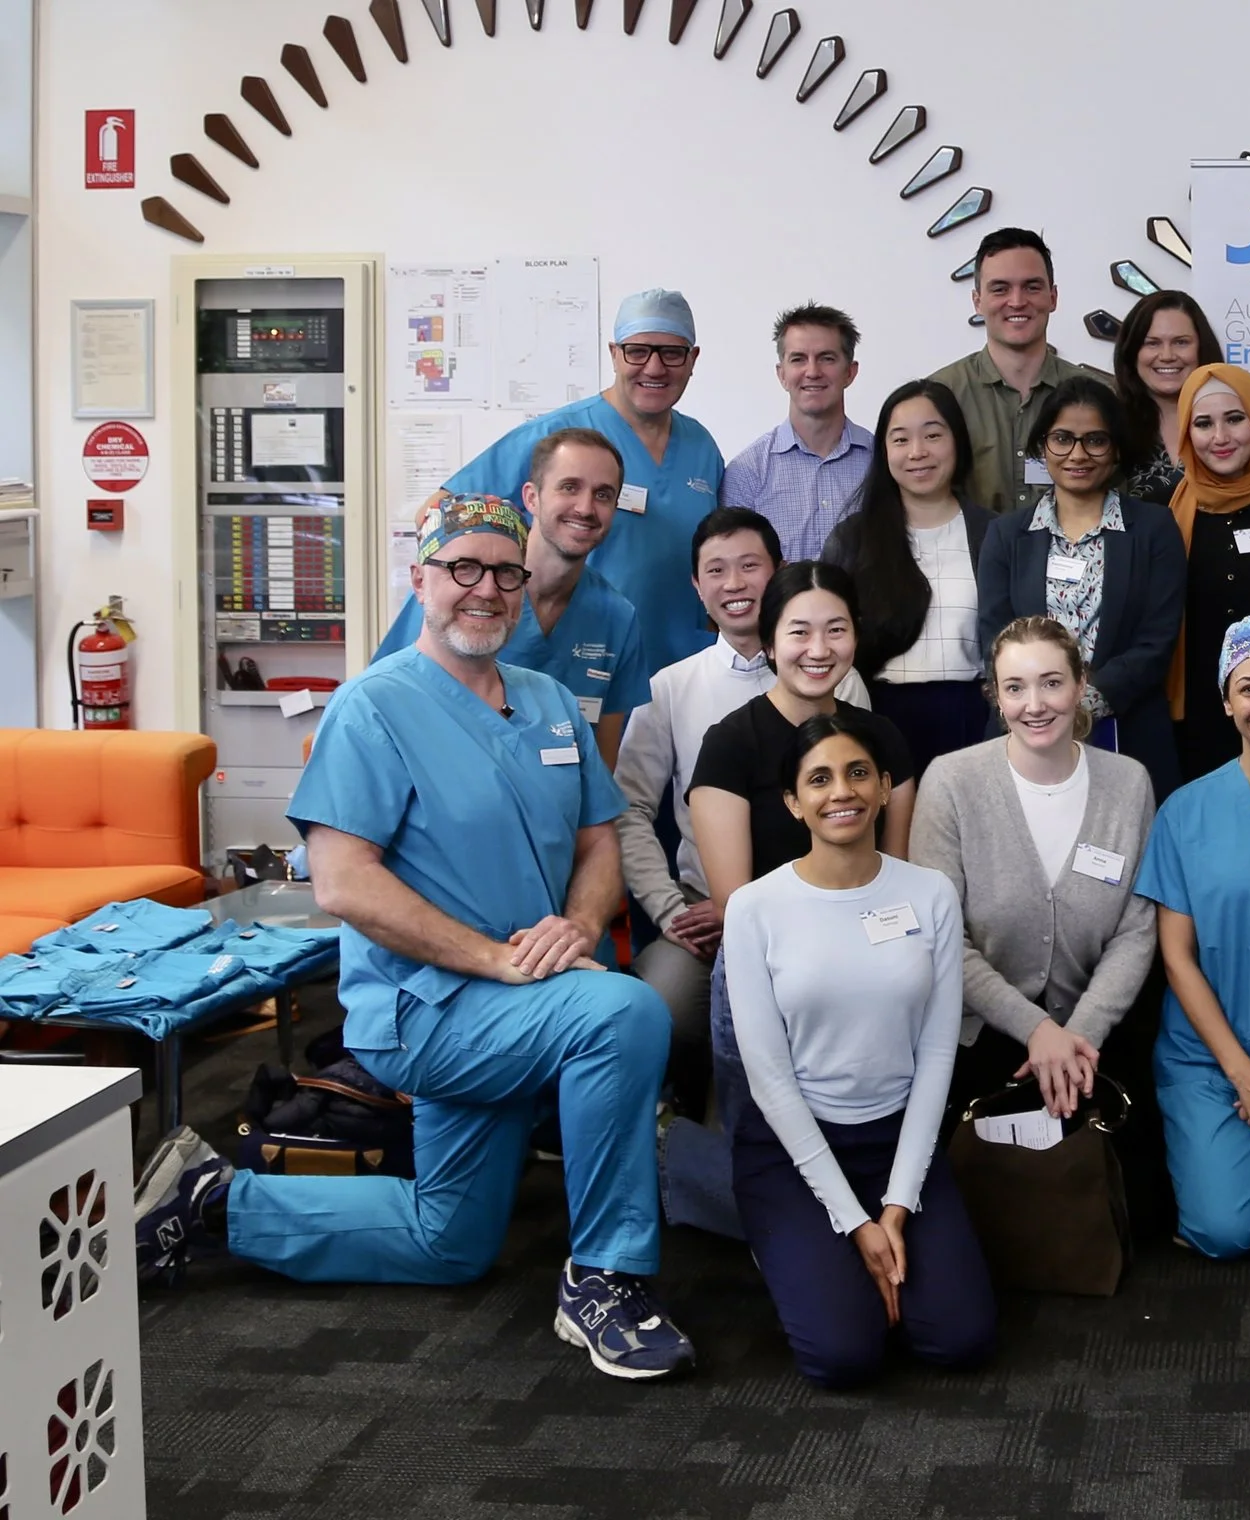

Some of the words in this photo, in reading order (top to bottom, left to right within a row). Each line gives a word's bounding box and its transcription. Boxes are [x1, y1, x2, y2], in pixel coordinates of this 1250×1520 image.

[102, 161, 118, 171] FIRE
[86, 172, 133, 184] EXTINGUISHER
[107, 436, 123, 444] DRY
[96, 443, 135, 451] CHEMICAL
[156, 1215, 184, 1251] N
[578, 1299, 608, 1330] N
